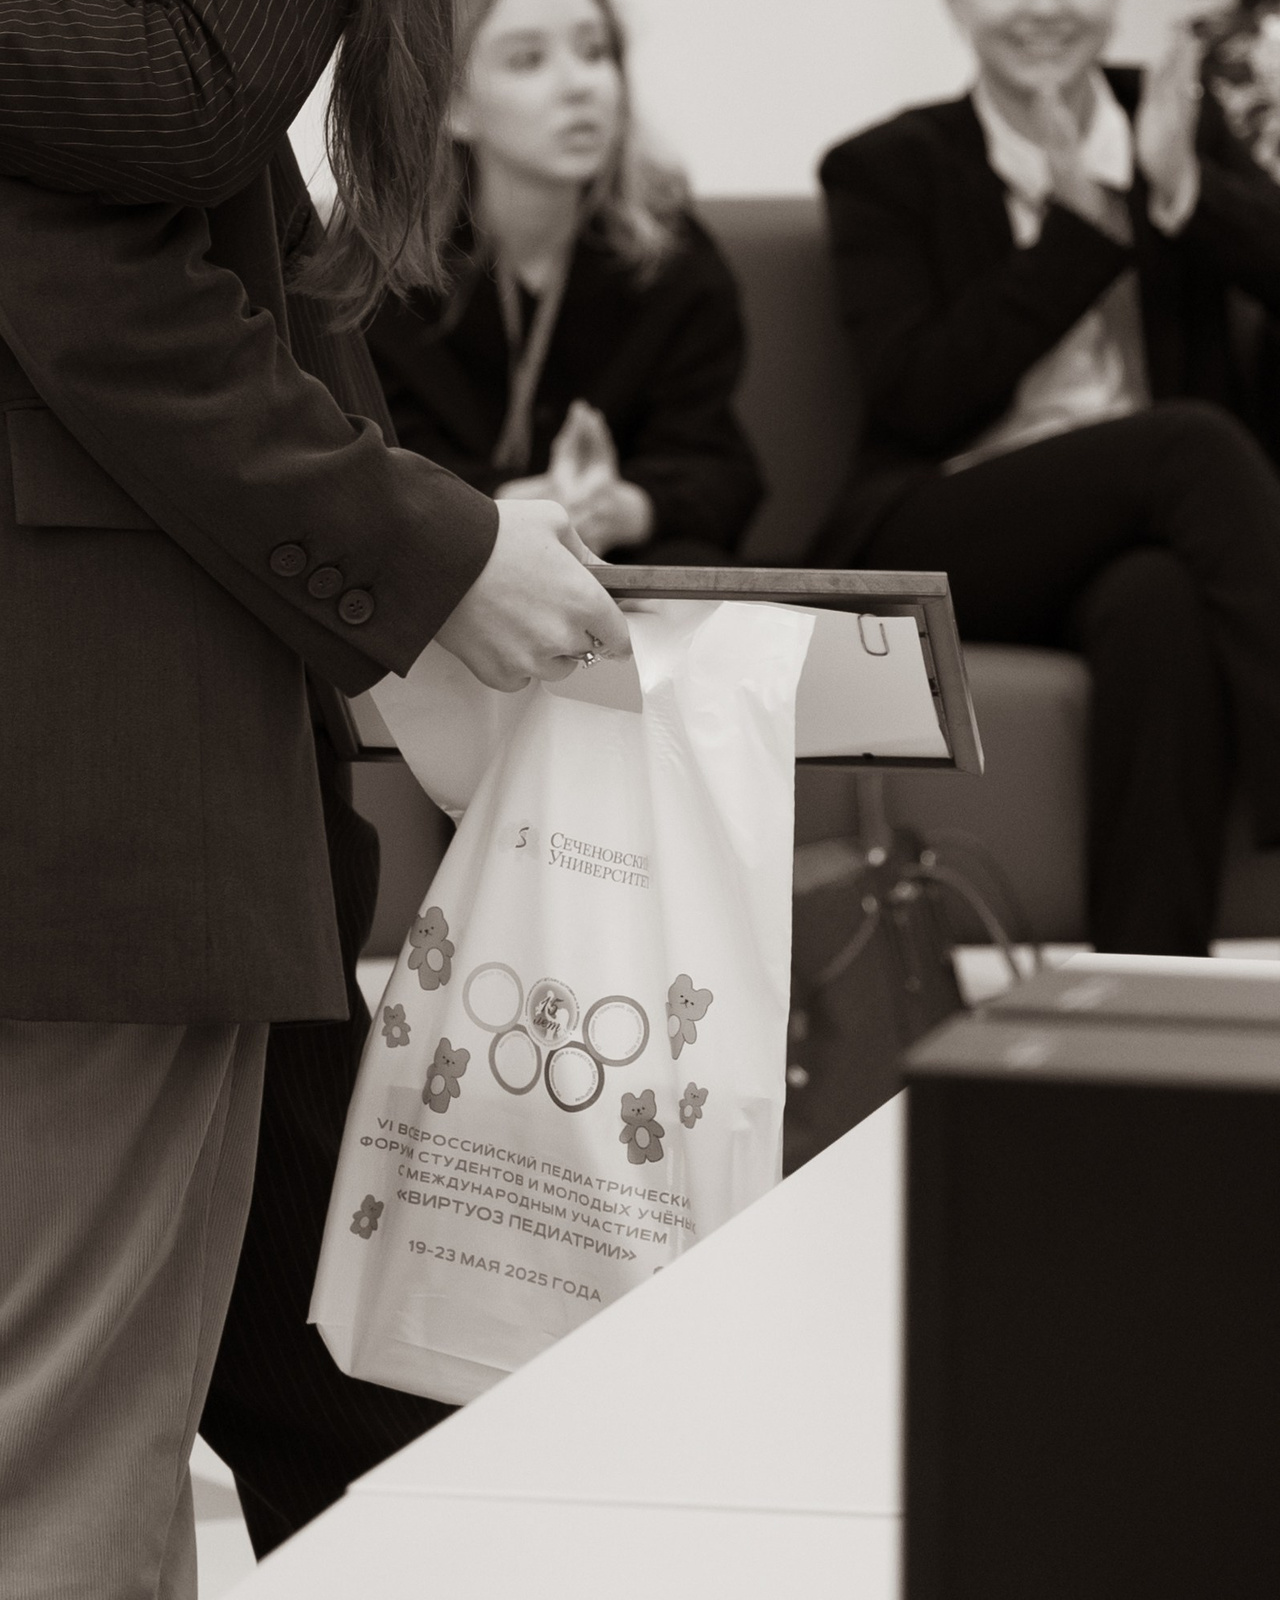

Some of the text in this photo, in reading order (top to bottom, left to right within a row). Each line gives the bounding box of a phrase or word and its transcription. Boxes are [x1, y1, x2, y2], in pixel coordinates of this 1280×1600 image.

[360, 1136, 414, 1159] ФОРУМ
[418, 1151, 524, 1186] СТУДЕНТОВ
[528, 1177, 539, 1191] И
[543, 1182, 632, 1217] МОЛОДЫХ
[377, 1117, 691, 1209] VI ВСЕРОССИЙСКИЙ ПЕДИАТРИЧЕСКИ
[397, 1189, 637, 1261] «ВИРТУОЗ ПЕДИАТРИИ»
[406, 1168, 567, 1218] МЕЖДУНАРОДНЫМ
[571, 1210, 668, 1244] УЧАСТИЕМ
[408, 1239, 602, 1302] 19-23 МАЯ 2025 ГОДА
